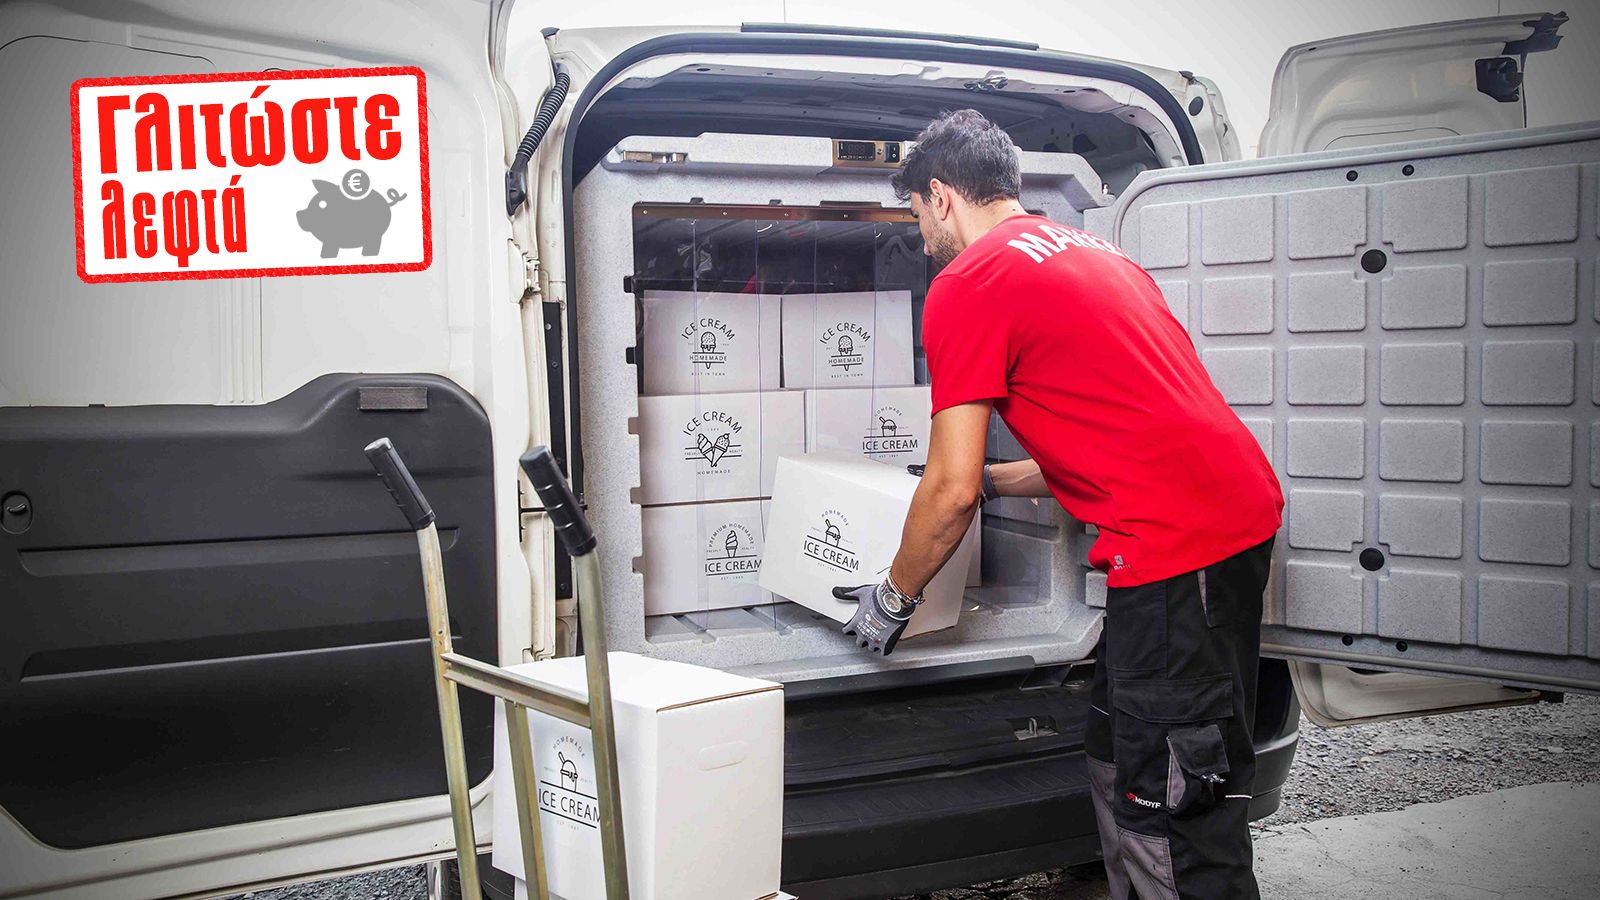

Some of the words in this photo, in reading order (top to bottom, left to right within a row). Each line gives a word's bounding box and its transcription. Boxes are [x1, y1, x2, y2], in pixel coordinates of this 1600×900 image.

[681, 322, 698, 339] ICE
[700, 318, 735, 340] CREAM
[819, 327, 835, 344] ICE
[836, 322, 871, 342] CREAM
[683, 416, 701, 435] ICE
[703, 411, 742, 433] CREAM
[862, 440, 878, 451] ICE
[882, 439, 918, 450] CREAM
[821, 509, 848, 526] HOMEMADE
[708, 524, 727, 548] PREMIUM
[729, 523, 754, 544] HOMEMADE
[803, 540, 820, 556] ICE
[822, 548, 859, 570] CREAM
[704, 562, 721, 573] ICE
[553, 736, 585, 757] HOMEMADE
[538, 788, 556, 809] ICE
